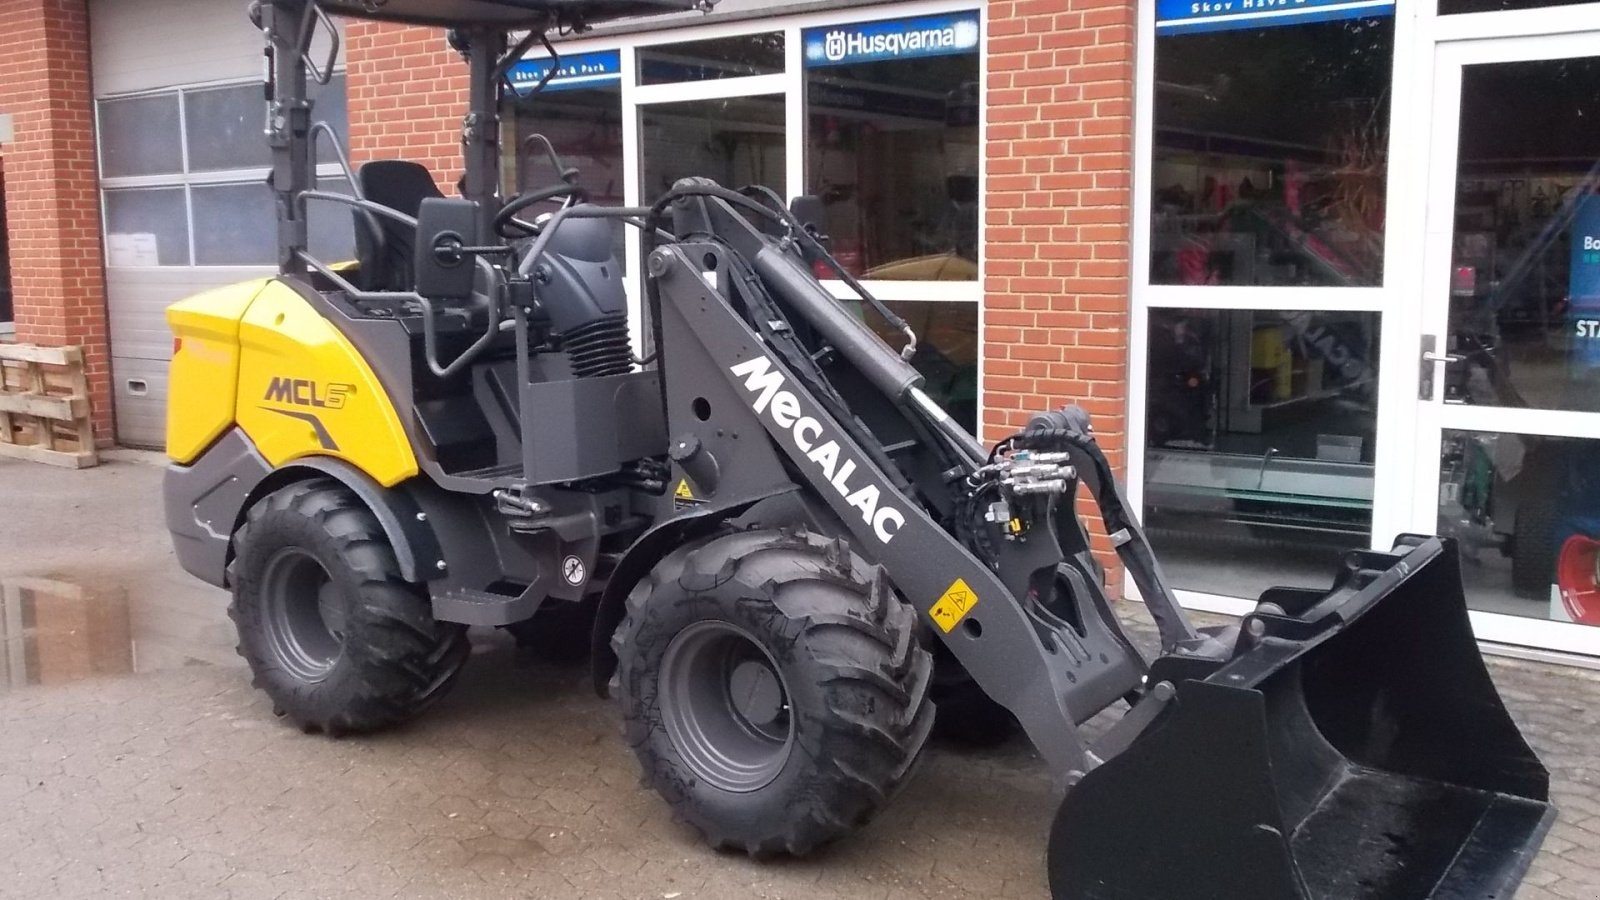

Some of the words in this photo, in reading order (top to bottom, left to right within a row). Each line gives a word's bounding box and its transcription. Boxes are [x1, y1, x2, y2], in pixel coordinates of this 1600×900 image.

[1191, 3, 1232, 13] Skov
[847, 28, 954, 55] Husqvarna
[581, 63, 605, 73] Park
[264, 376, 356, 410] MCL6
